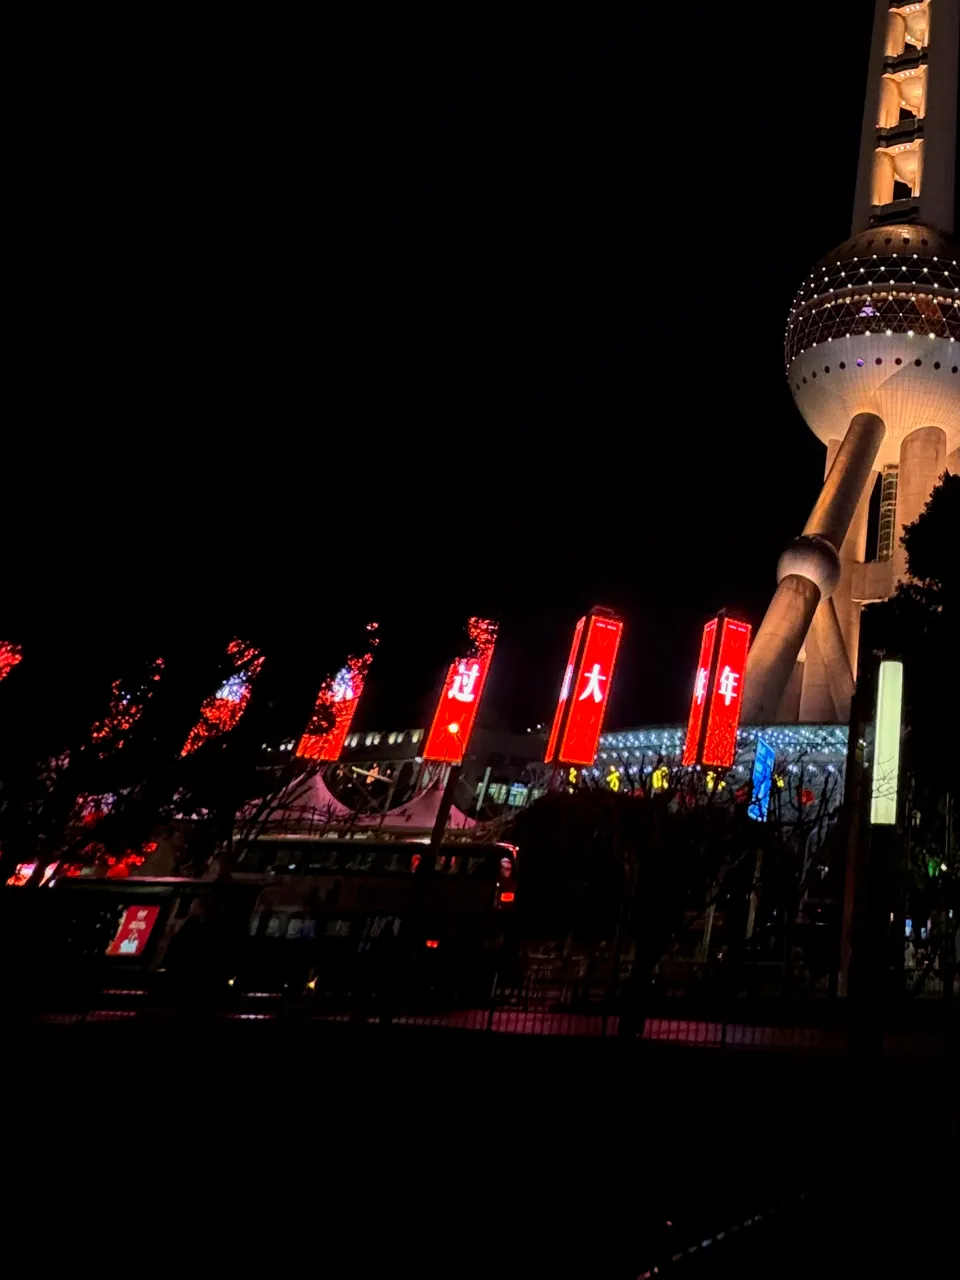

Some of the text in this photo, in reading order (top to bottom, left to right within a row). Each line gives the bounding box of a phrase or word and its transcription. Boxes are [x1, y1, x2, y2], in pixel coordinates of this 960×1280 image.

[447, 663, 480, 702] 过
[578, 663, 607, 703] 大
[718, 665, 740, 706] 年
